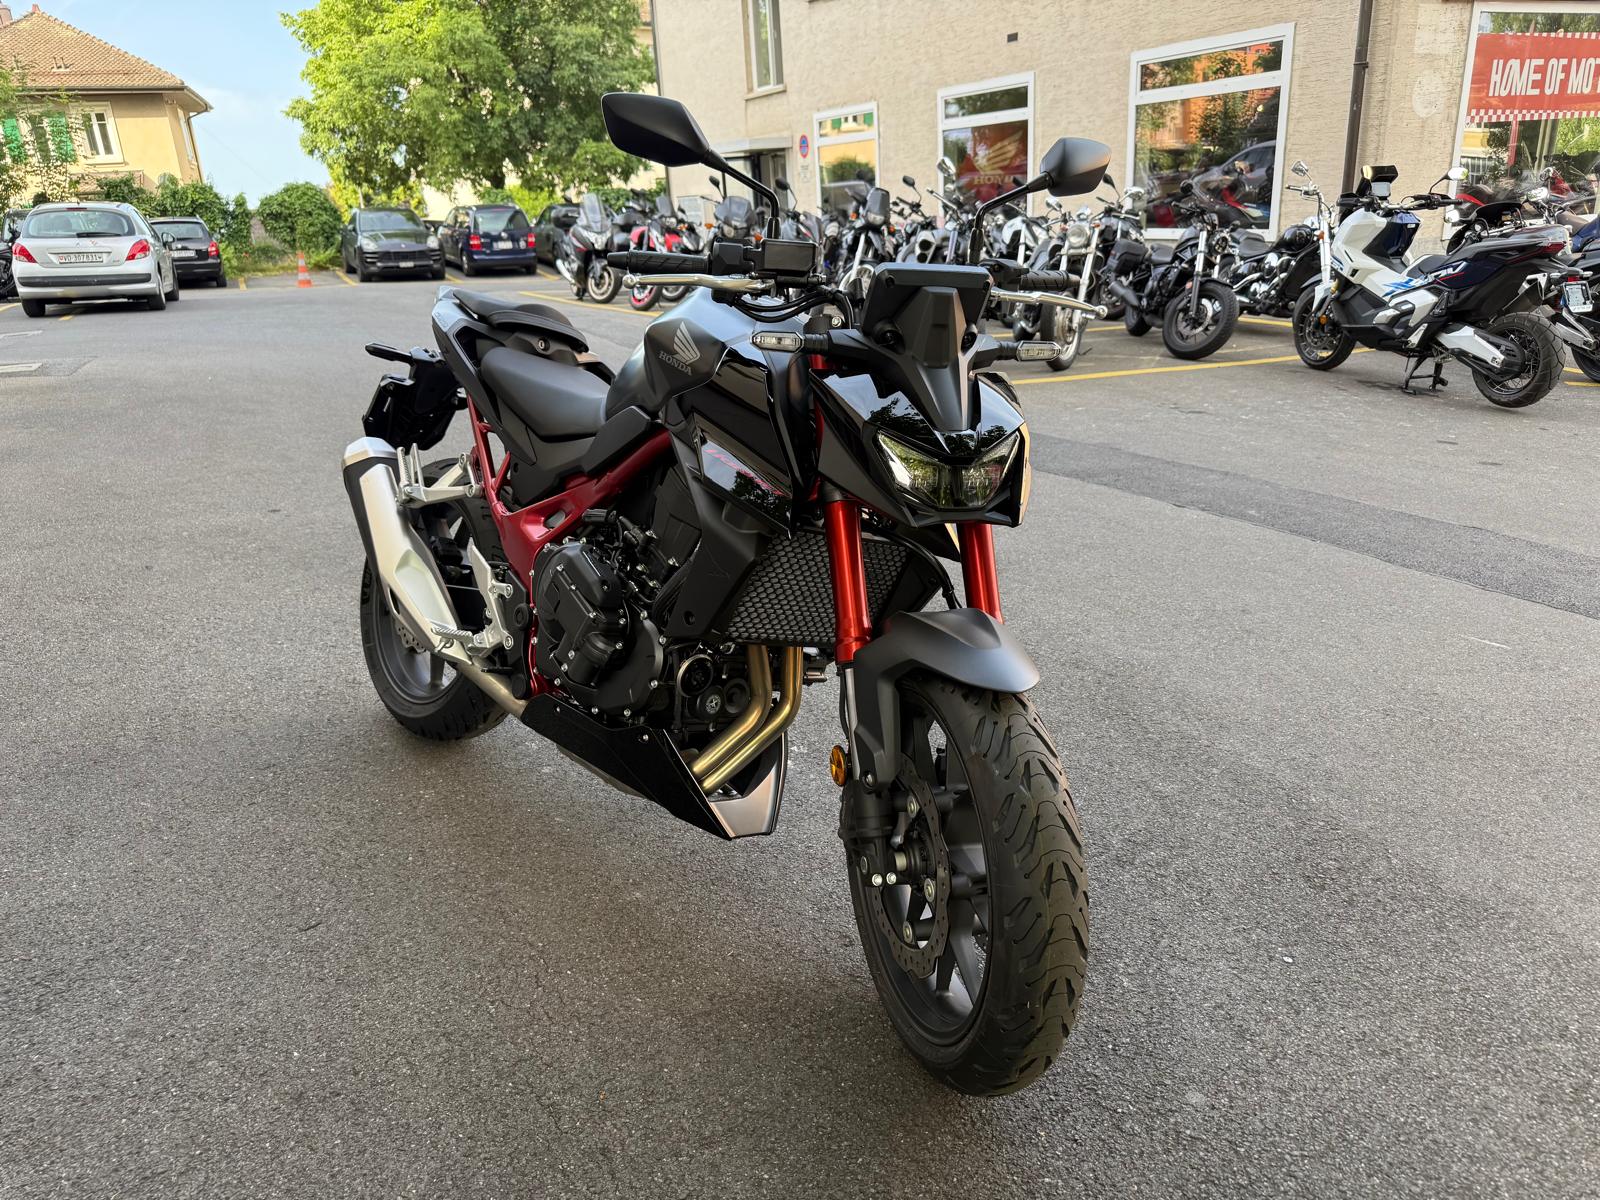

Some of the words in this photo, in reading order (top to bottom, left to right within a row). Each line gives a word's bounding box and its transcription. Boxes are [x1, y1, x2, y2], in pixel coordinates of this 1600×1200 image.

[1488, 58, 1544, 97] HOME
[1544, 57, 1568, 95] OF
[658, 350, 692, 376] HONDA
